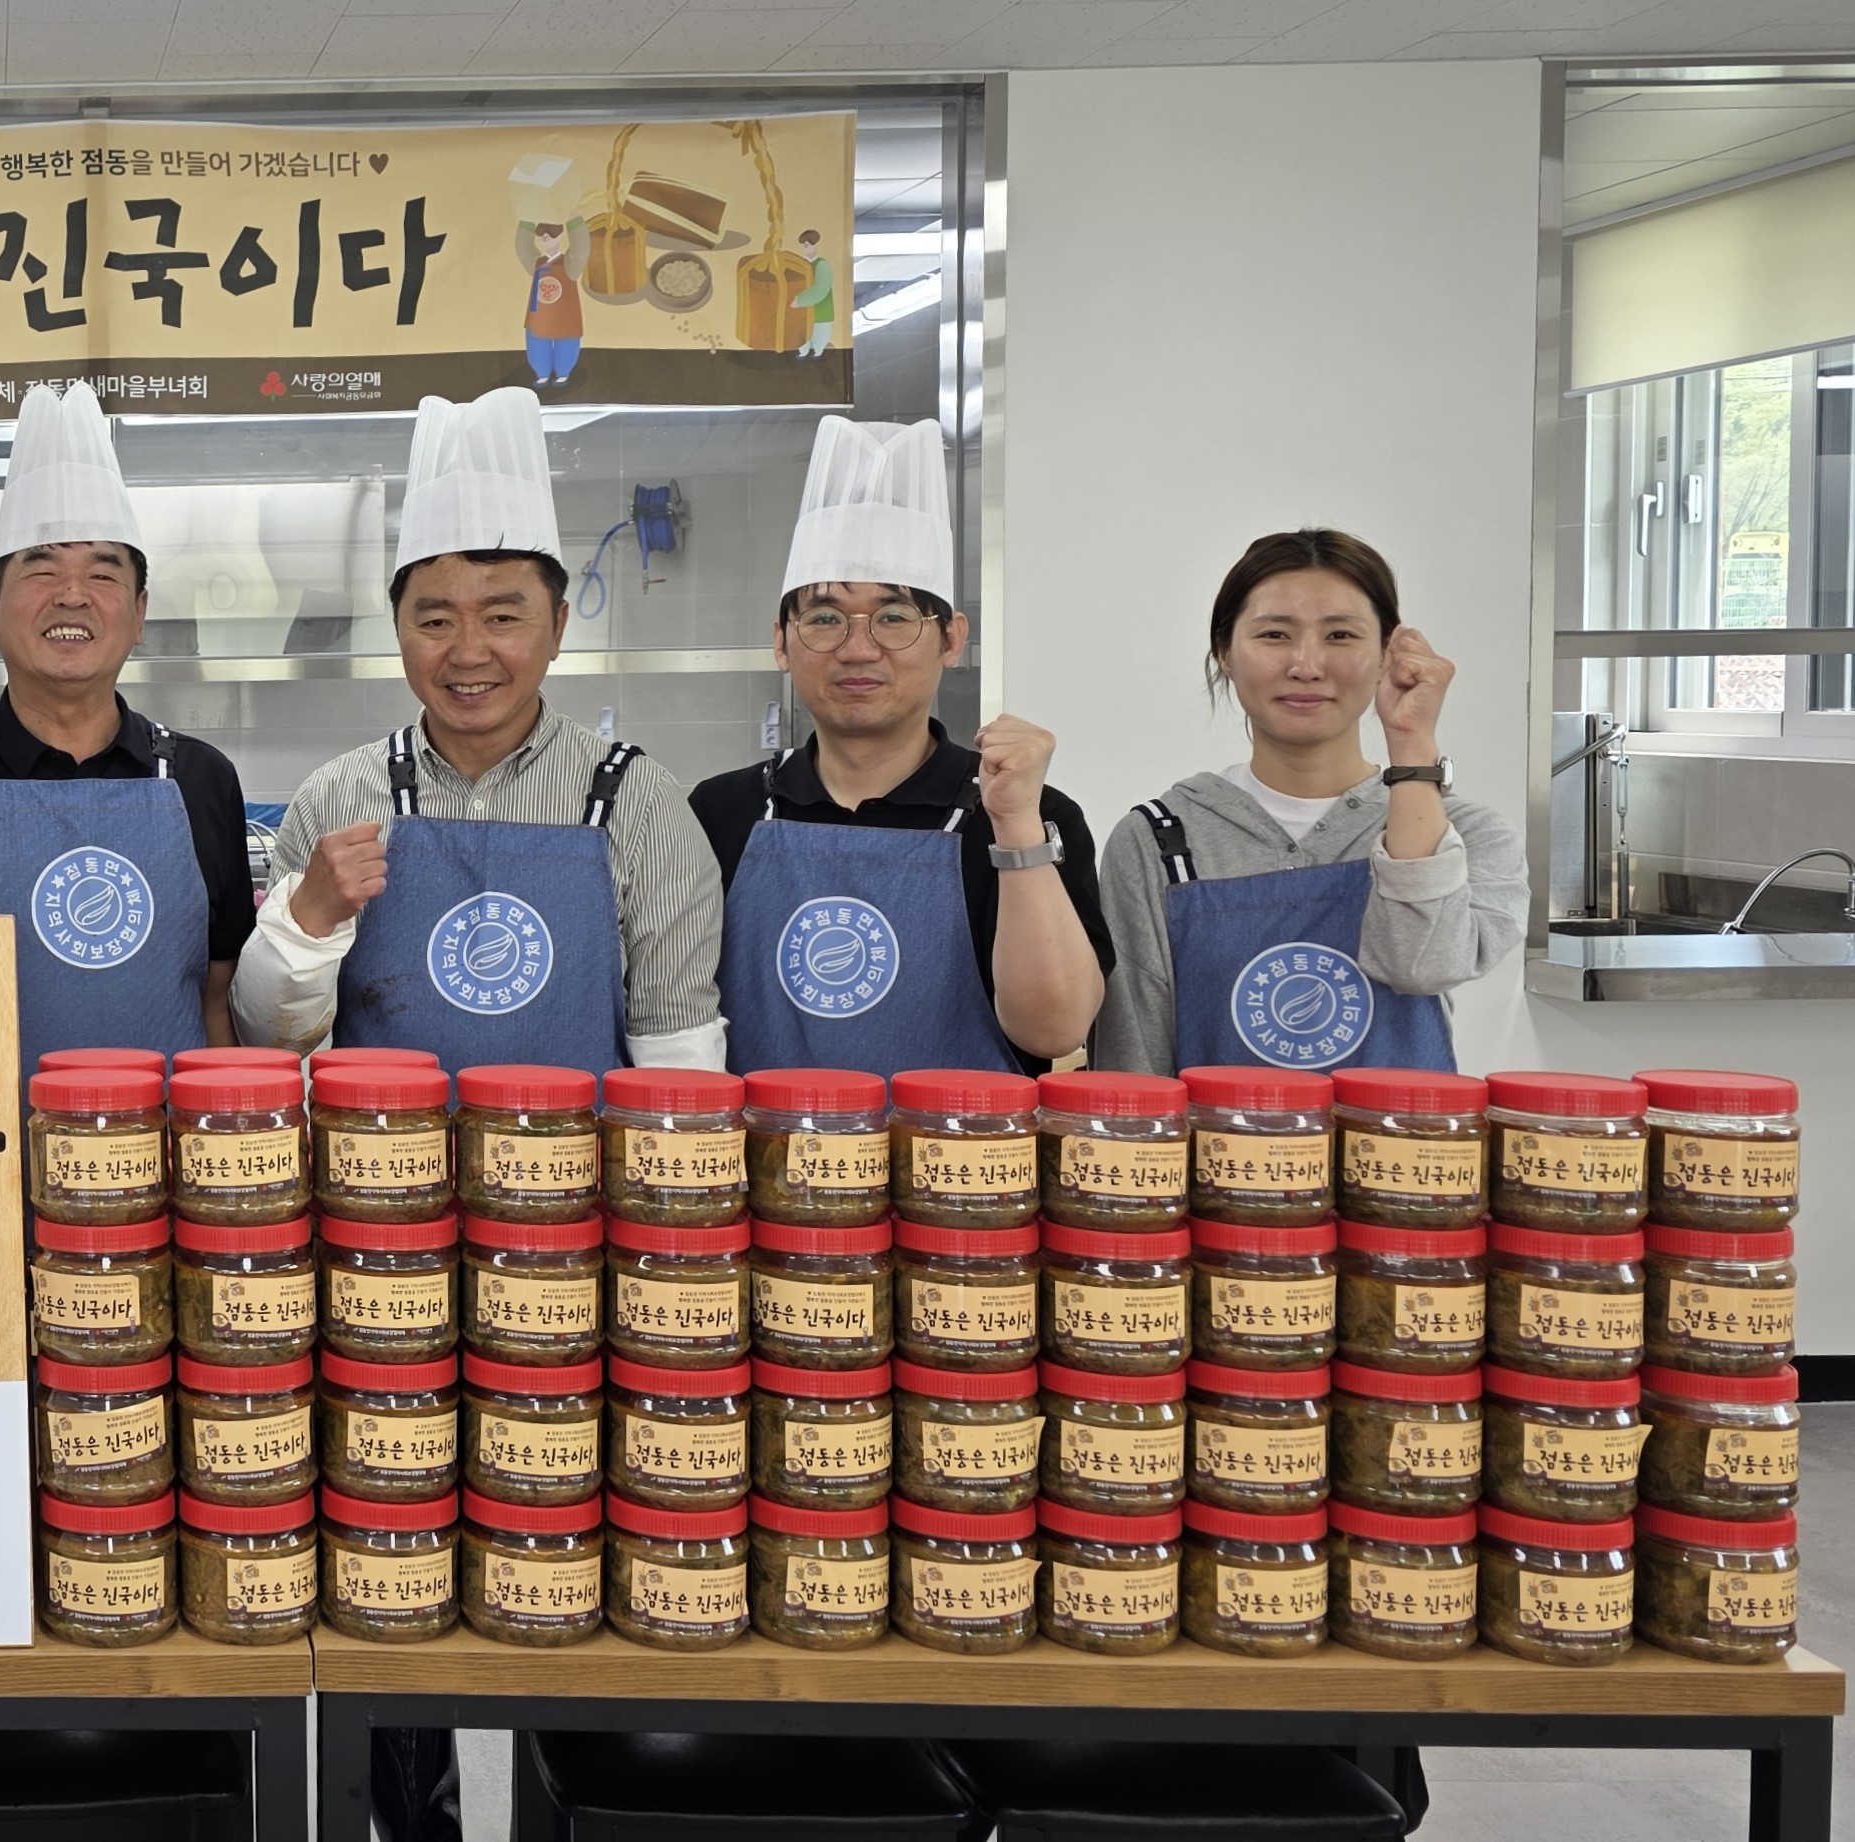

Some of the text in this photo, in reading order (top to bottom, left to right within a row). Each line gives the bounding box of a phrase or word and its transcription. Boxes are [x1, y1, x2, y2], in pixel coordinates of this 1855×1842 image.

[0, 149, 74, 179] 행복한
[80, 148, 154, 176] 점동을
[160, 151, 231, 177] 만들어
[238, 151, 361, 178] 가겠습니다
[290, 371, 382, 393] 사랑의열매
[64, 857, 121, 881] 점동면
[468, 902, 525, 926] 점동면
[814, 907, 875, 932] 점동면
[1268, 953, 1335, 979] 점동면
[56, 1155, 159, 1181] 점동은 진국이다
[189, 1151, 293, 1178] 점동은 진국이다
[338, 1153, 442, 1179] 점동은 진국이다
[495, 1159, 595, 1182] 점동은 진국이다
[637, 1156, 685, 1179] 점동은
[800, 1158, 849, 1179] 점동은
[923, 1161, 1033, 1185] 점동은 진국이다
[1073, 1161, 1183, 1188] 점동은 진국이다
[1207, 1157, 1258, 1181] 점동은
[1263, 1159, 1324, 1182] 진국이다
[1354, 1158, 1475, 1187] 점동은 진국이다
[1516, 1155, 1638, 1184] 점동은 진국이다
[1678, 1162, 1795, 1188] 점동은 진국이다
[71, 1298, 133, 1320] 진국이다
[225, 1302, 272, 1323] 점동은
[340, 1295, 443, 1320] 점동은 진국이다
[487, 1299, 592, 1325] 점동은 진국이다
[625, 1301, 733, 1329] 점동은 진국이다
[757, 1298, 797, 1325] 점동은
[802, 1308, 866, 1329] 진국이다
[923, 1307, 1032, 1333] 점동은 진국이다
[1223, 1303, 1276, 1327] 점동은
[1065, 1308, 1179, 1334] 점동은 진국이다
[1411, 1312, 1460, 1333] 점동은
[1535, 1313, 1589, 1339] 점동은
[1683, 1308, 1739, 1333] 점동은
[58, 1421, 160, 1457] 점동은 진국이다
[203, 1431, 305, 1465] 점동은 진국이다
[356, 1437, 405, 1461] 점동은
[487, 1440, 594, 1468] 점동은 진국이다
[636, 1443, 741, 1471] 점동은 진국이다
[799, 1447, 847, 1469] 점동은
[936, 1447, 987, 1470] 점동은
[1072, 1448, 1123, 1474] 점동은
[1206, 1447, 1321, 1475] 점동은 진국이다
[1404, 1447, 1454, 1469] 점동은
[1539, 1449, 1594, 1474] 점동은
[1722, 1453, 1773, 1476] 점동은
[57, 1579, 159, 1607] 점동은 진국이다
[239, 1582, 285, 1604] 점동은
[343, 1573, 448, 1601] 점동은 진국이다
[493, 1581, 597, 1607] 점동은 진국이다
[800, 1581, 848, 1605] 점동은
[924, 1581, 1031, 1610] 점동은 진국이다
[639, 1588, 690, 1614] 점동은
[1065, 1590, 1115, 1615] 점동은
[1231, 1592, 1283, 1615] 점동은
[1364, 1589, 1417, 1615] 점동은
[1534, 1599, 1589, 1623] 점동은
[1723, 1597, 1774, 1619] 점동은
